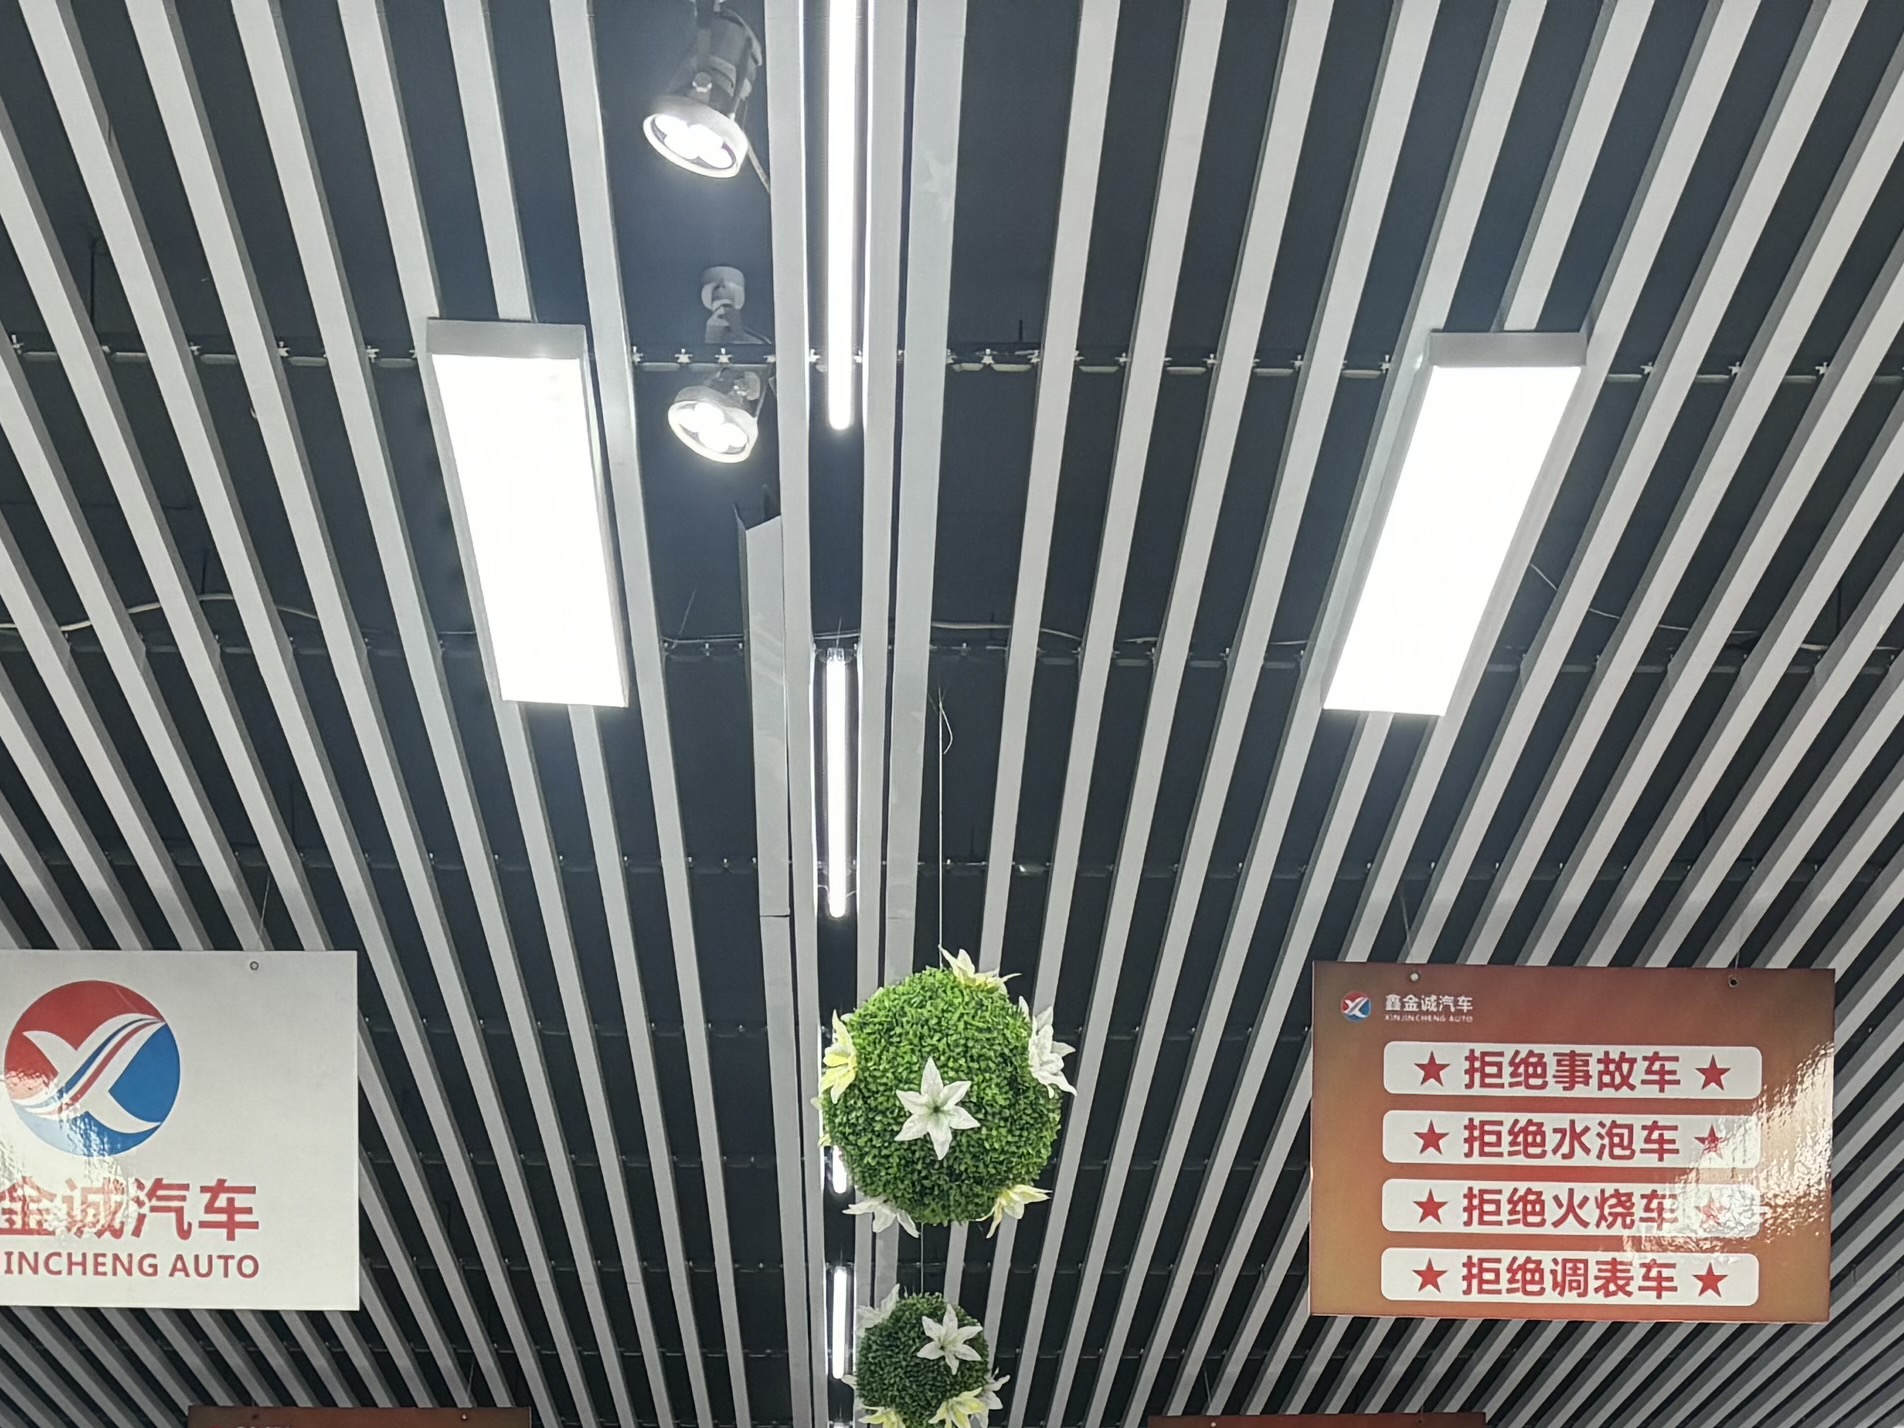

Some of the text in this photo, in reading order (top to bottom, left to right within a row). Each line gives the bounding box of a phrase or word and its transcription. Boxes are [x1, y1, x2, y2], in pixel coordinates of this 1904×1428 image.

[1384, 993, 1474, 1013] 鑫金诚汽车
[1463, 1049, 1682, 1093] 拒绝事故车
[1463, 1118, 1681, 1162] 拒绝水泡车
[1462, 1186, 1680, 1231] 拒绝火烧车
[168, 1253, 261, 1280] AUTO
[1462, 1256, 1679, 1300] 拒绝调表车
